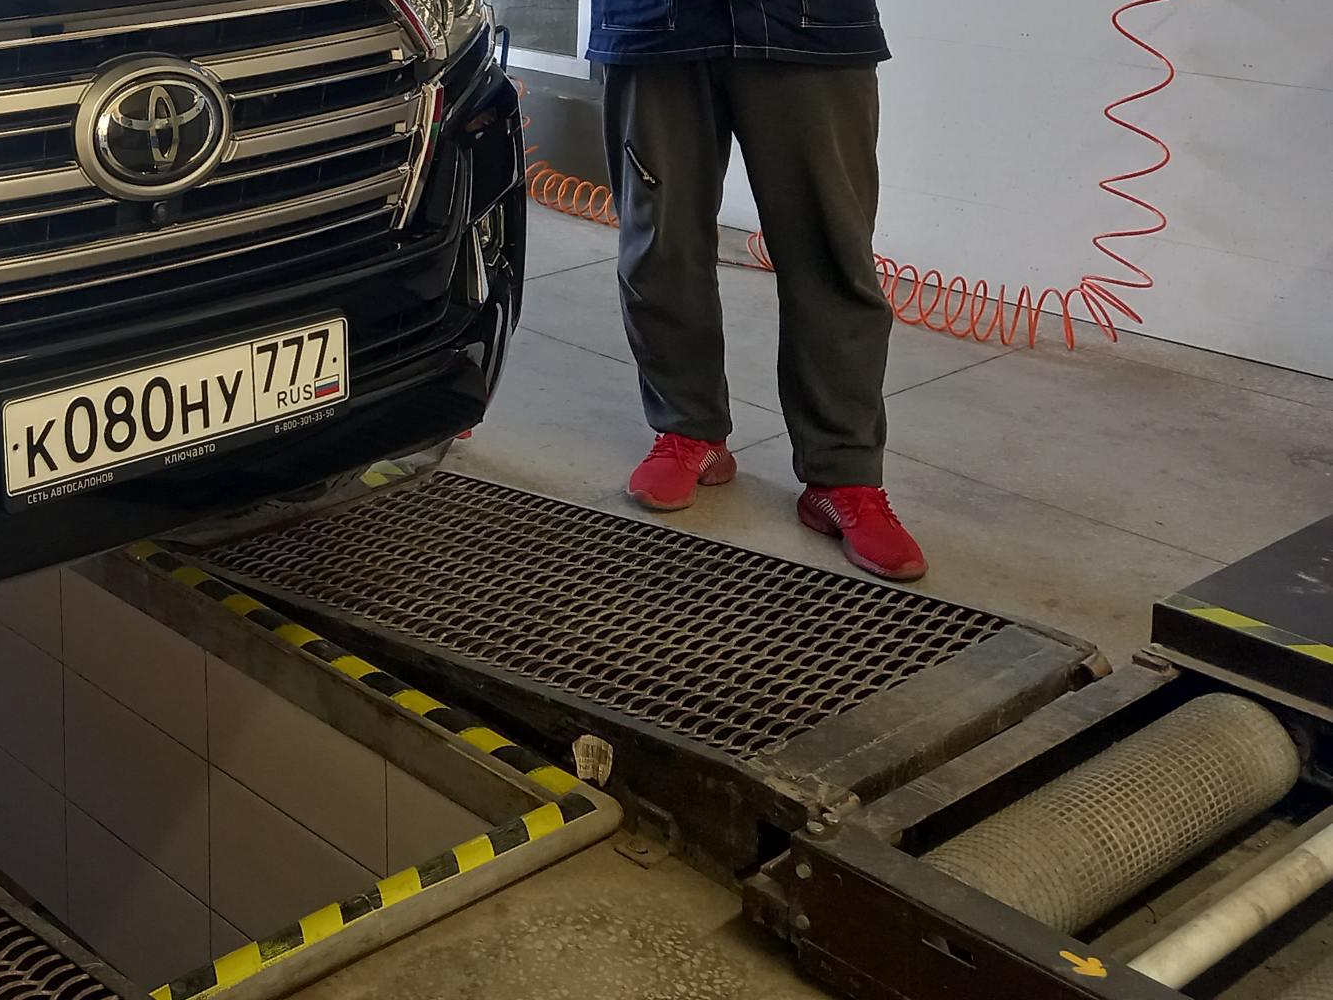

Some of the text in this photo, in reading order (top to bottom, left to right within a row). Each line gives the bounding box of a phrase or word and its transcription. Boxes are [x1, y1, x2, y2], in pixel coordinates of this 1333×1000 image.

[255, 328, 330, 394] 777
[276, 383, 314, 409] RUS
[26, 370, 244, 478] К080НУ
[27, 472, 114, 505] СЕТЬ АВТОСАЛОНОВ
